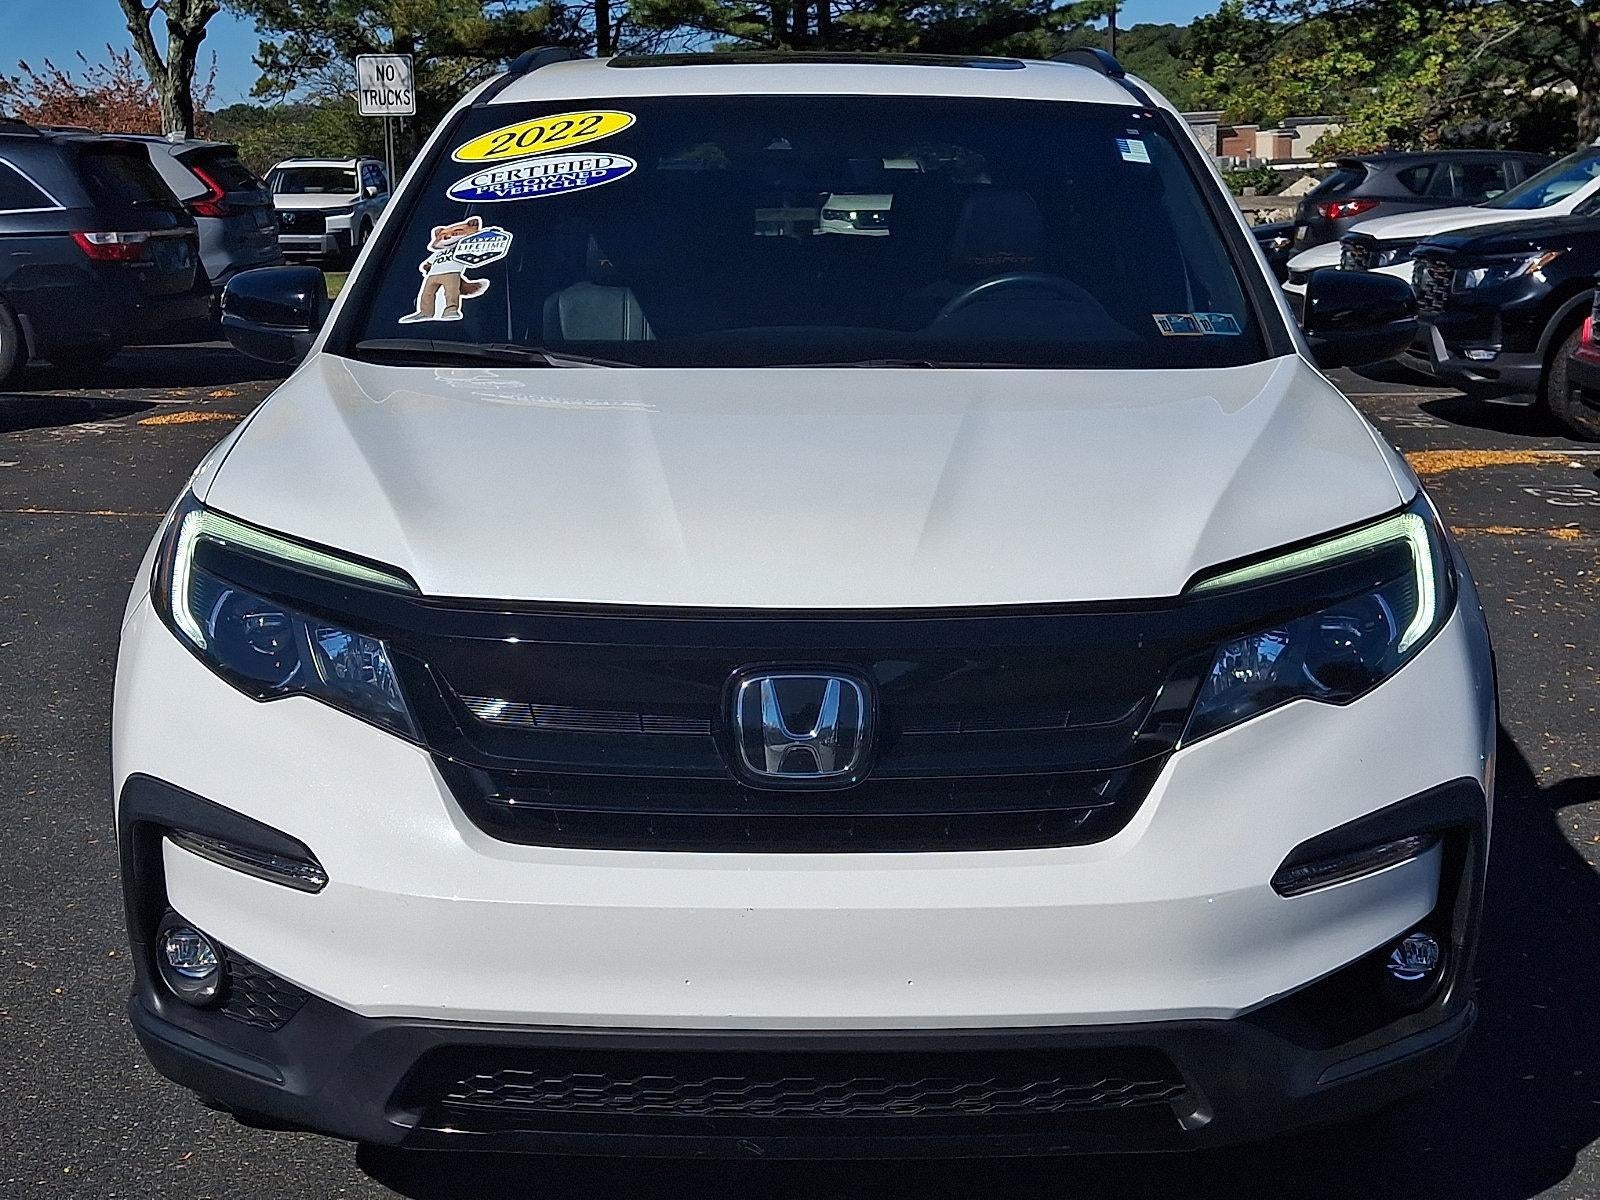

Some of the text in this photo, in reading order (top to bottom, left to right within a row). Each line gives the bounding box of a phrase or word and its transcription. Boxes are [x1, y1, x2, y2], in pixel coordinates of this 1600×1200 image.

[376, 64, 395, 82] NO
[362, 89, 411, 106] TRUCKS
[483, 115, 604, 157] 2022
[471, 157, 614, 187] CERTIFIED
[476, 169, 607, 195] PRE-OWNED
[494, 178, 588, 197] VEHICLE
[457, 241, 506, 251] LIFETIME
